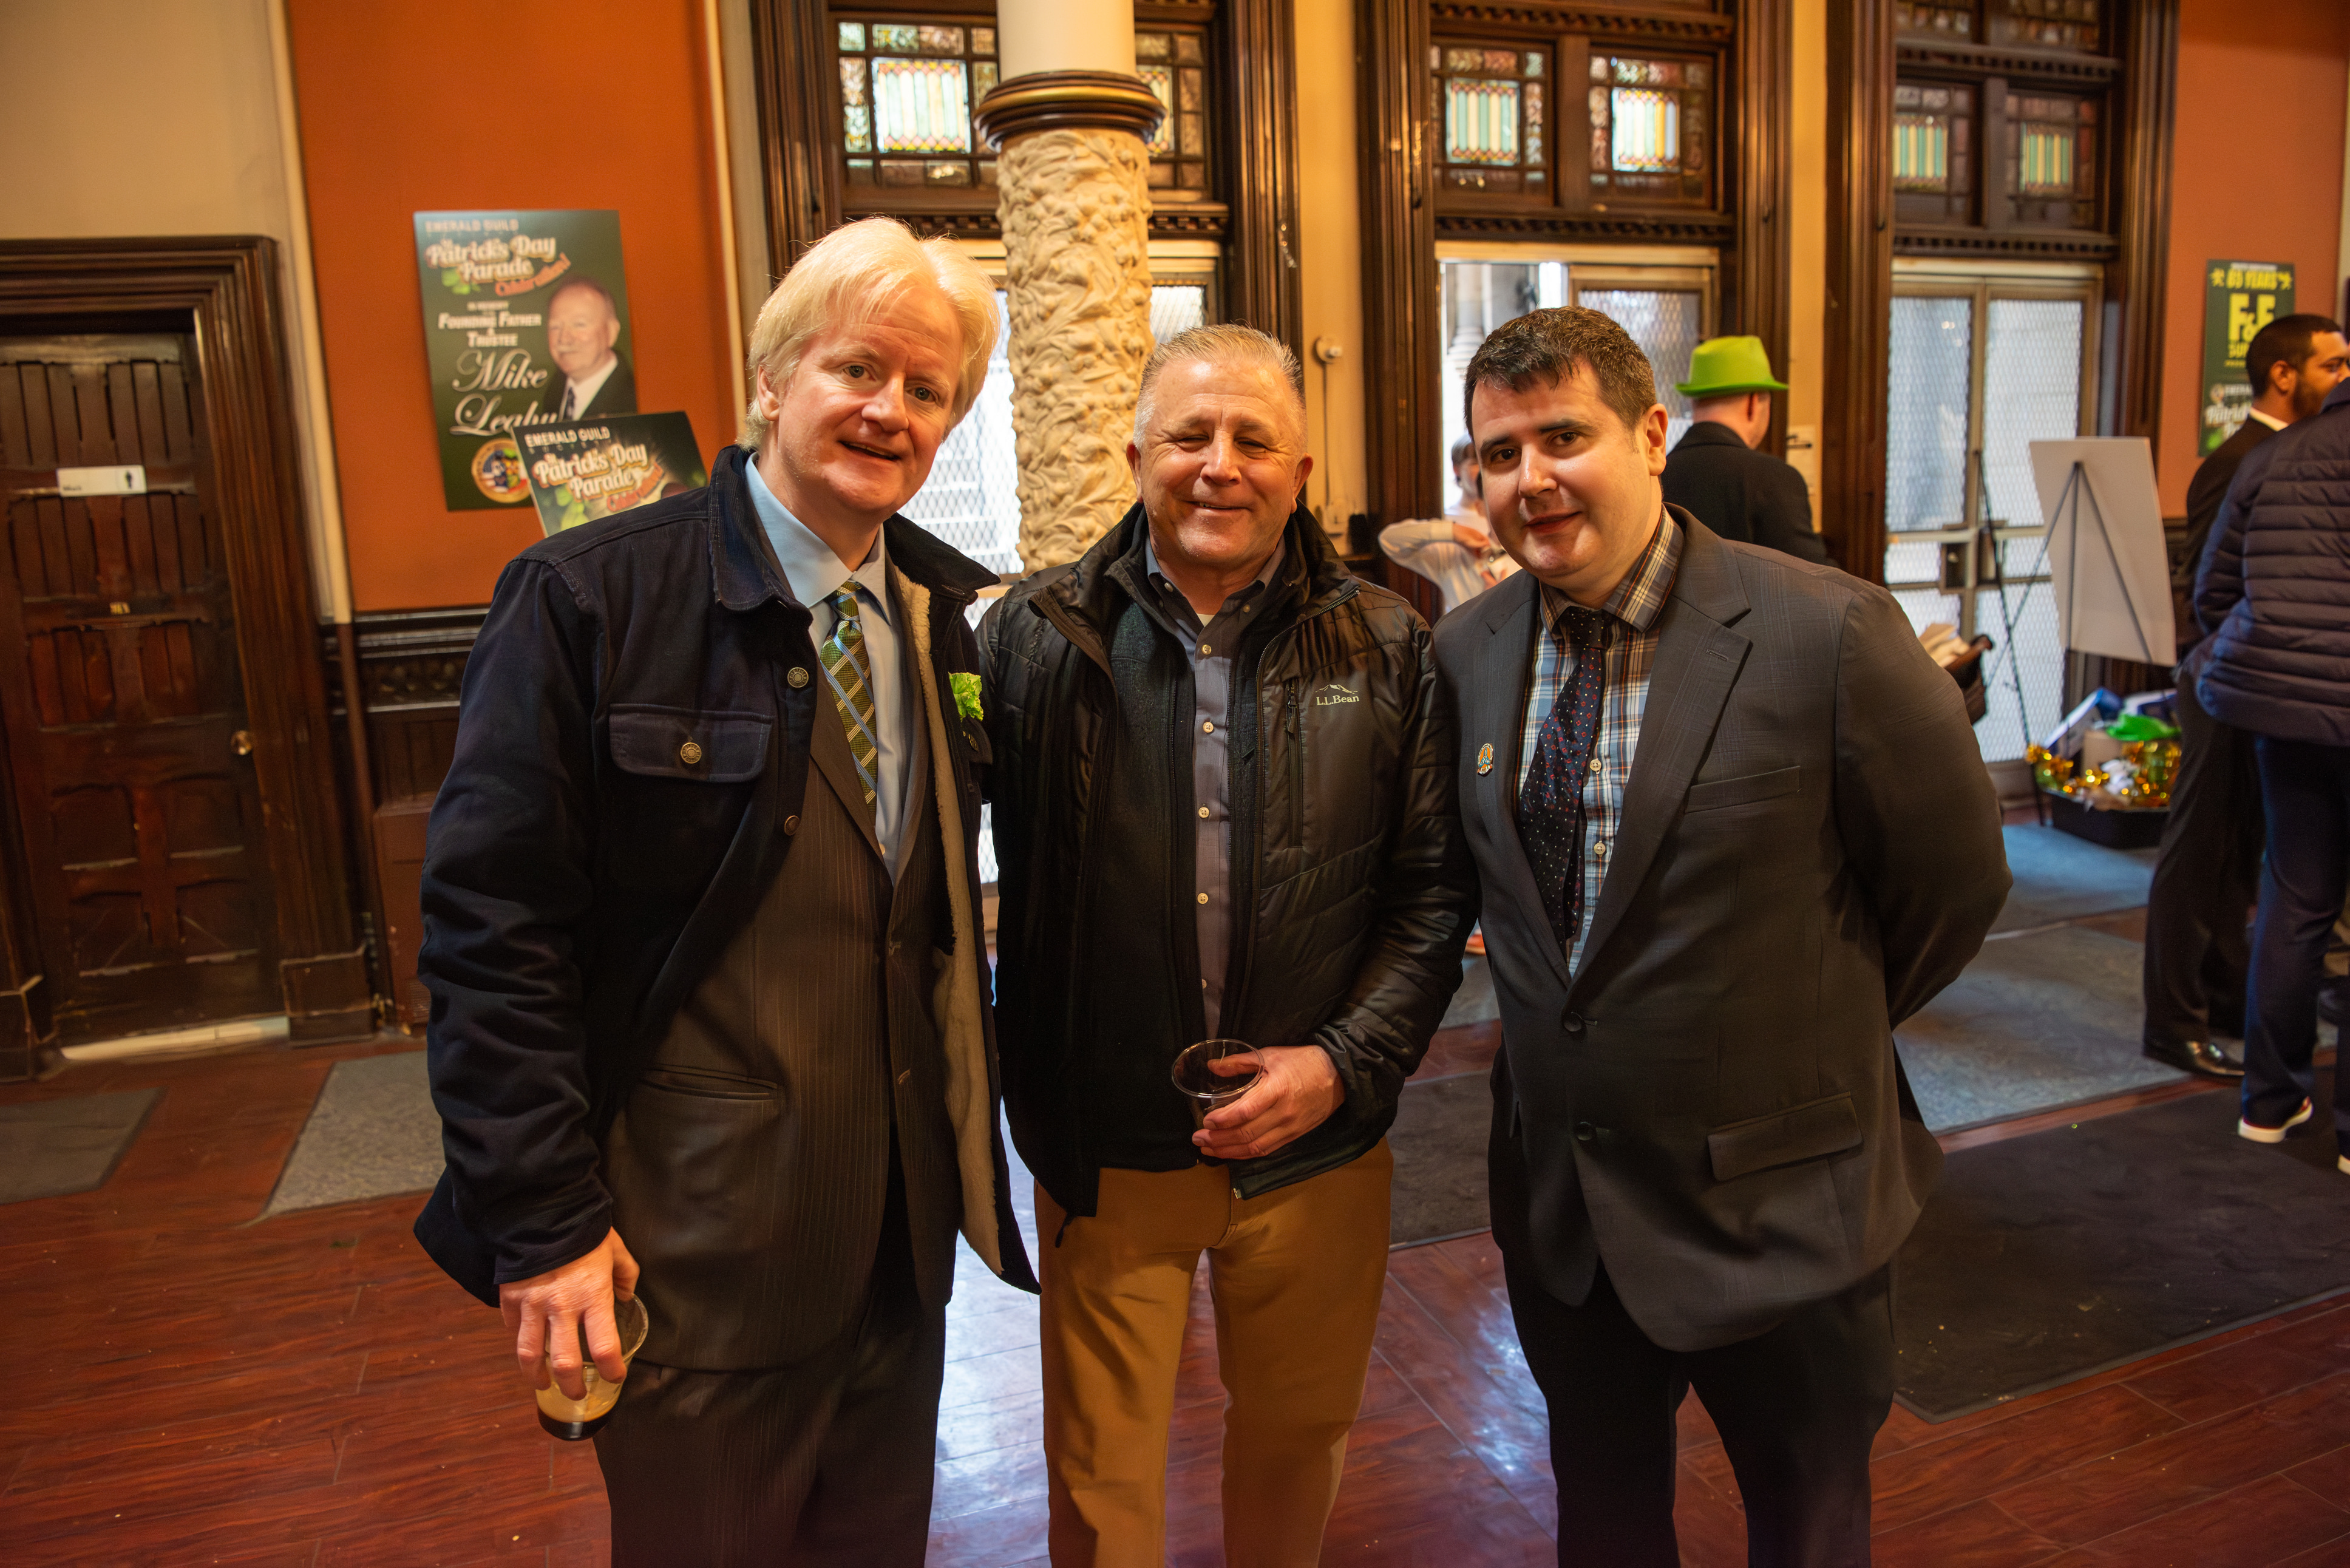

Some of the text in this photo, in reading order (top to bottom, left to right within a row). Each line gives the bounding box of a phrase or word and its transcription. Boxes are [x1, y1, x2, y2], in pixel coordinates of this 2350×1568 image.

[425, 219, 519, 232] EMERALD GUILD
[510, 234, 555, 262] Day
[458, 257, 534, 283] Parade
[452, 348, 548, 392] Mike
[525, 426, 610, 447] EMERALD GUILD
[532, 448, 610, 488] Patrick's
[609, 444, 649, 470] Day
[568, 467, 636, 503] Parade
[1316, 695, 1360, 705] L.L.Bean
